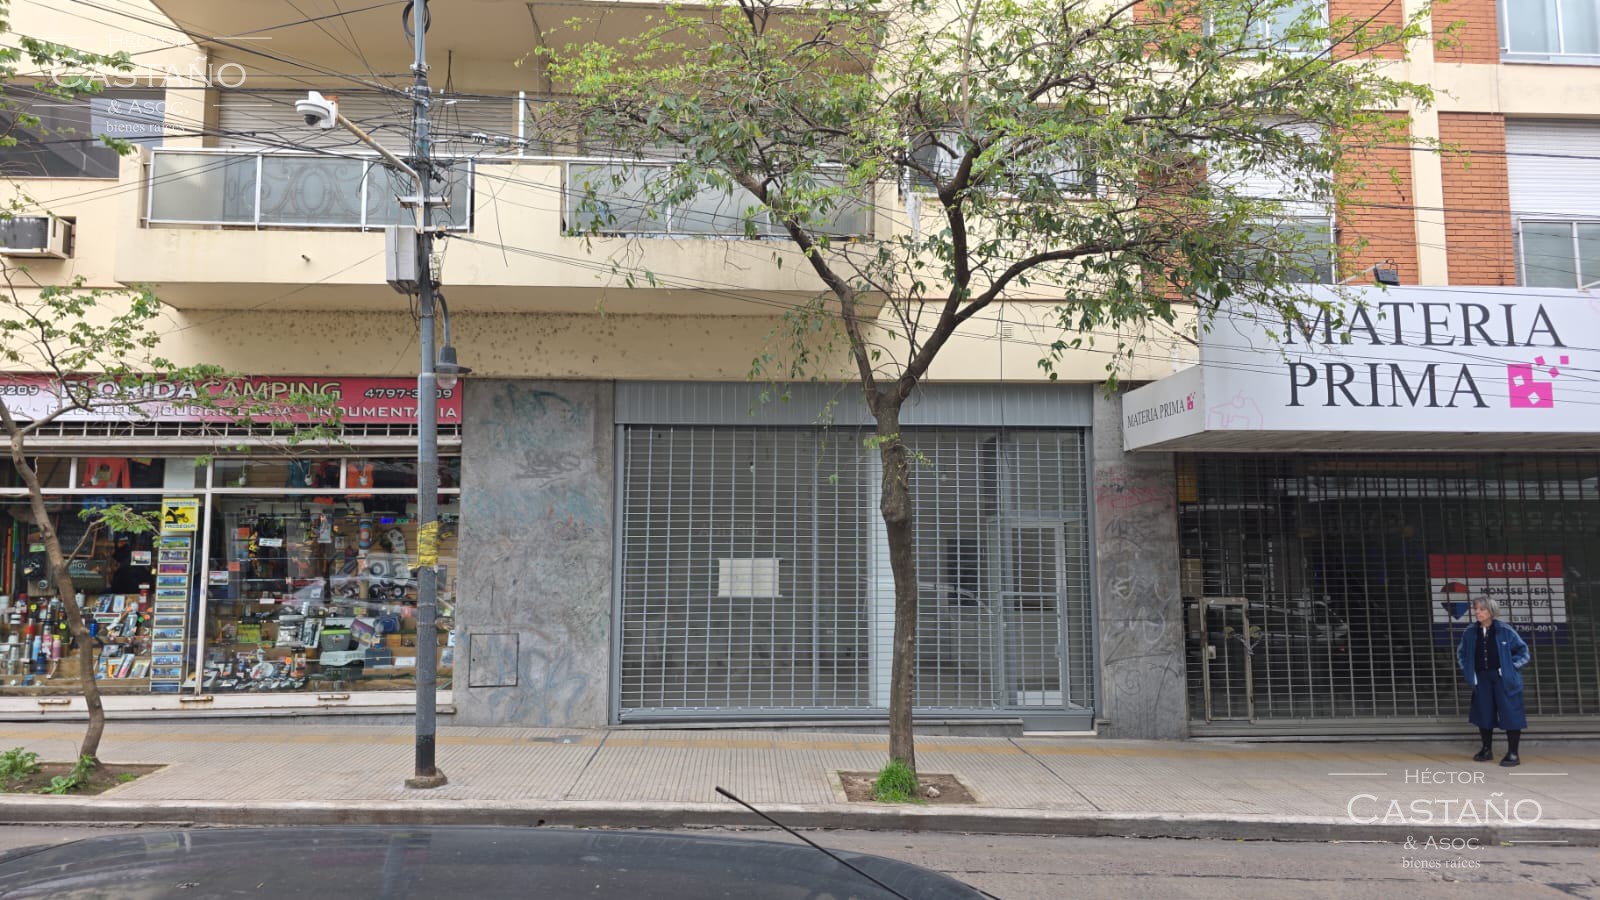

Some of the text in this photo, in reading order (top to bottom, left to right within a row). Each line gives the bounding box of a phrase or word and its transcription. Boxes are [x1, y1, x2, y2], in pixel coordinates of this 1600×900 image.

[1285, 301, 1567, 348] MATERIA
[365, 388, 453, 399] 4797-309
[1285, 362, 1491, 408] PRIMA
[312, 405, 458, 418] INDUMENTIA
[1127, 399, 1185, 428] MATERIA PRIMA
[1487, 562, 1543, 572] ALQUILA
